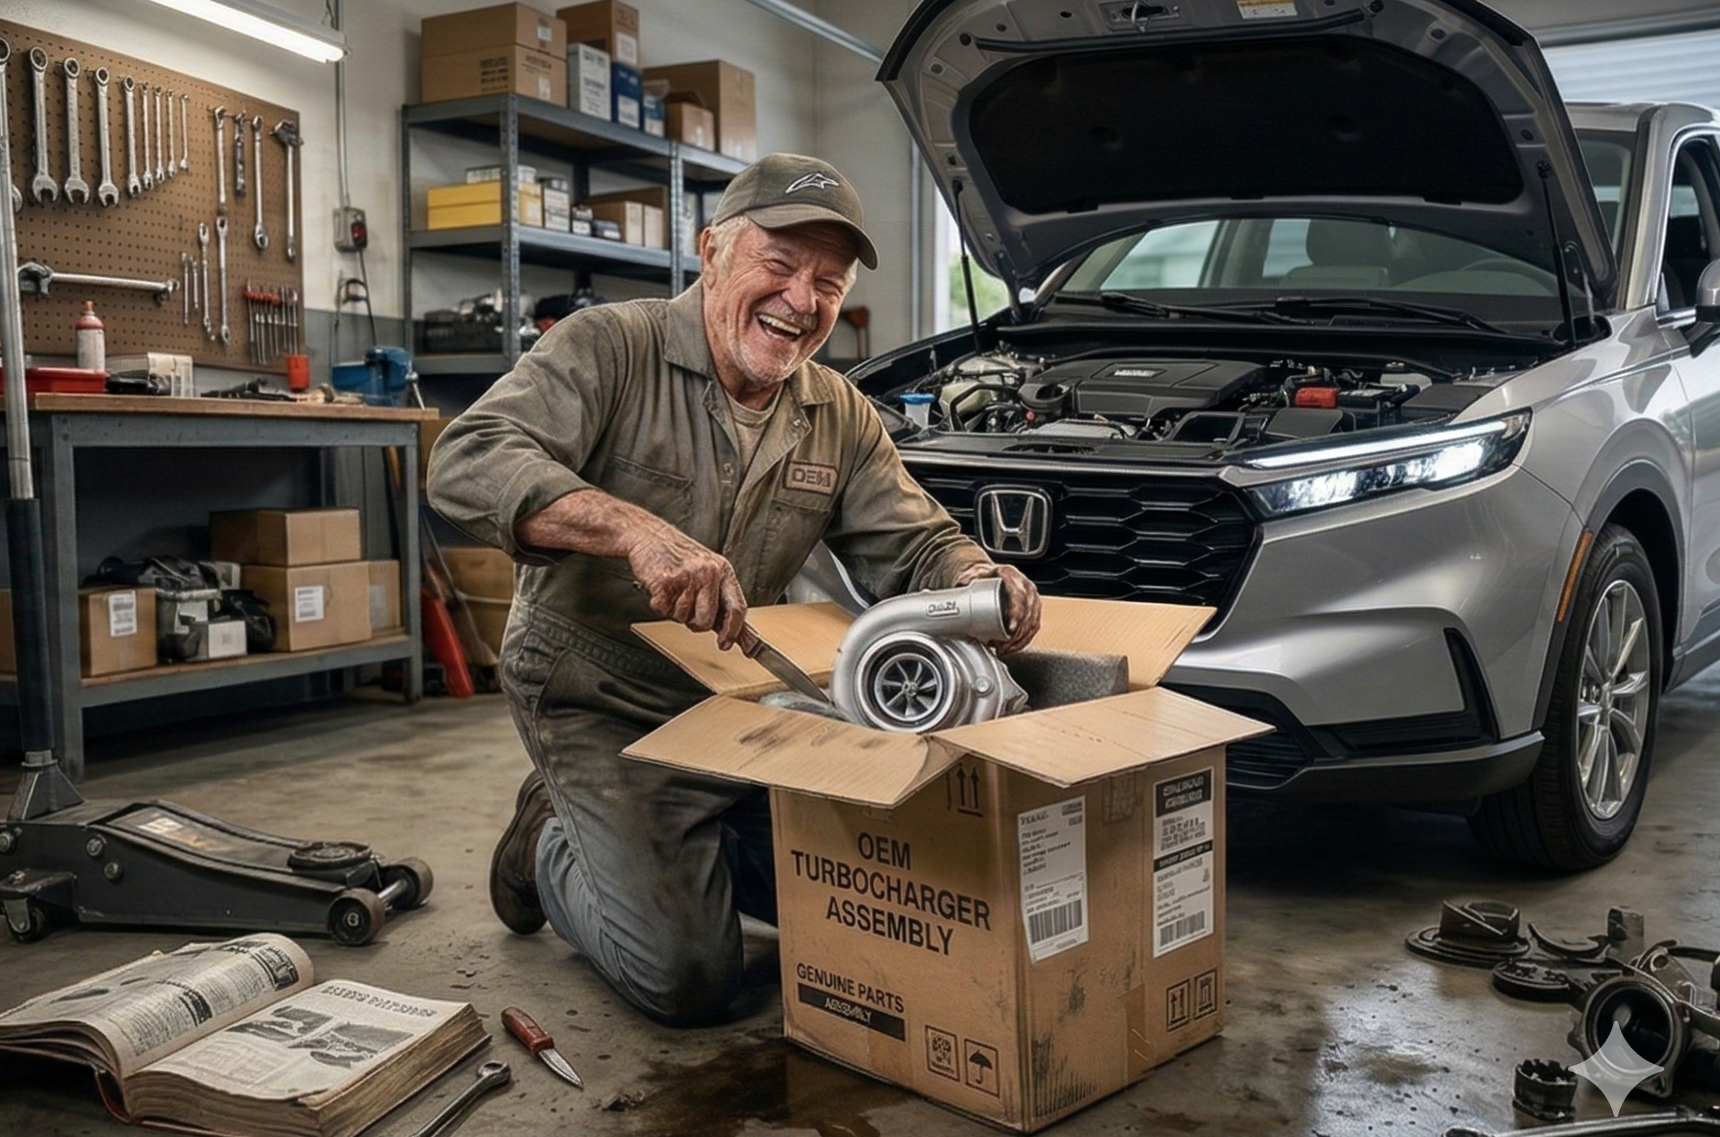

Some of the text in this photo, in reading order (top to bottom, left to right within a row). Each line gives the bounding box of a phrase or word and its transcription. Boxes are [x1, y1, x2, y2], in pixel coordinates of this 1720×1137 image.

[858, 832, 911, 870] OEM
[791, 850, 991, 931] TURBOCHARGER
[826, 896, 953, 956] ASSEMBLY
[797, 962, 904, 1014] GENUINE PARTS
